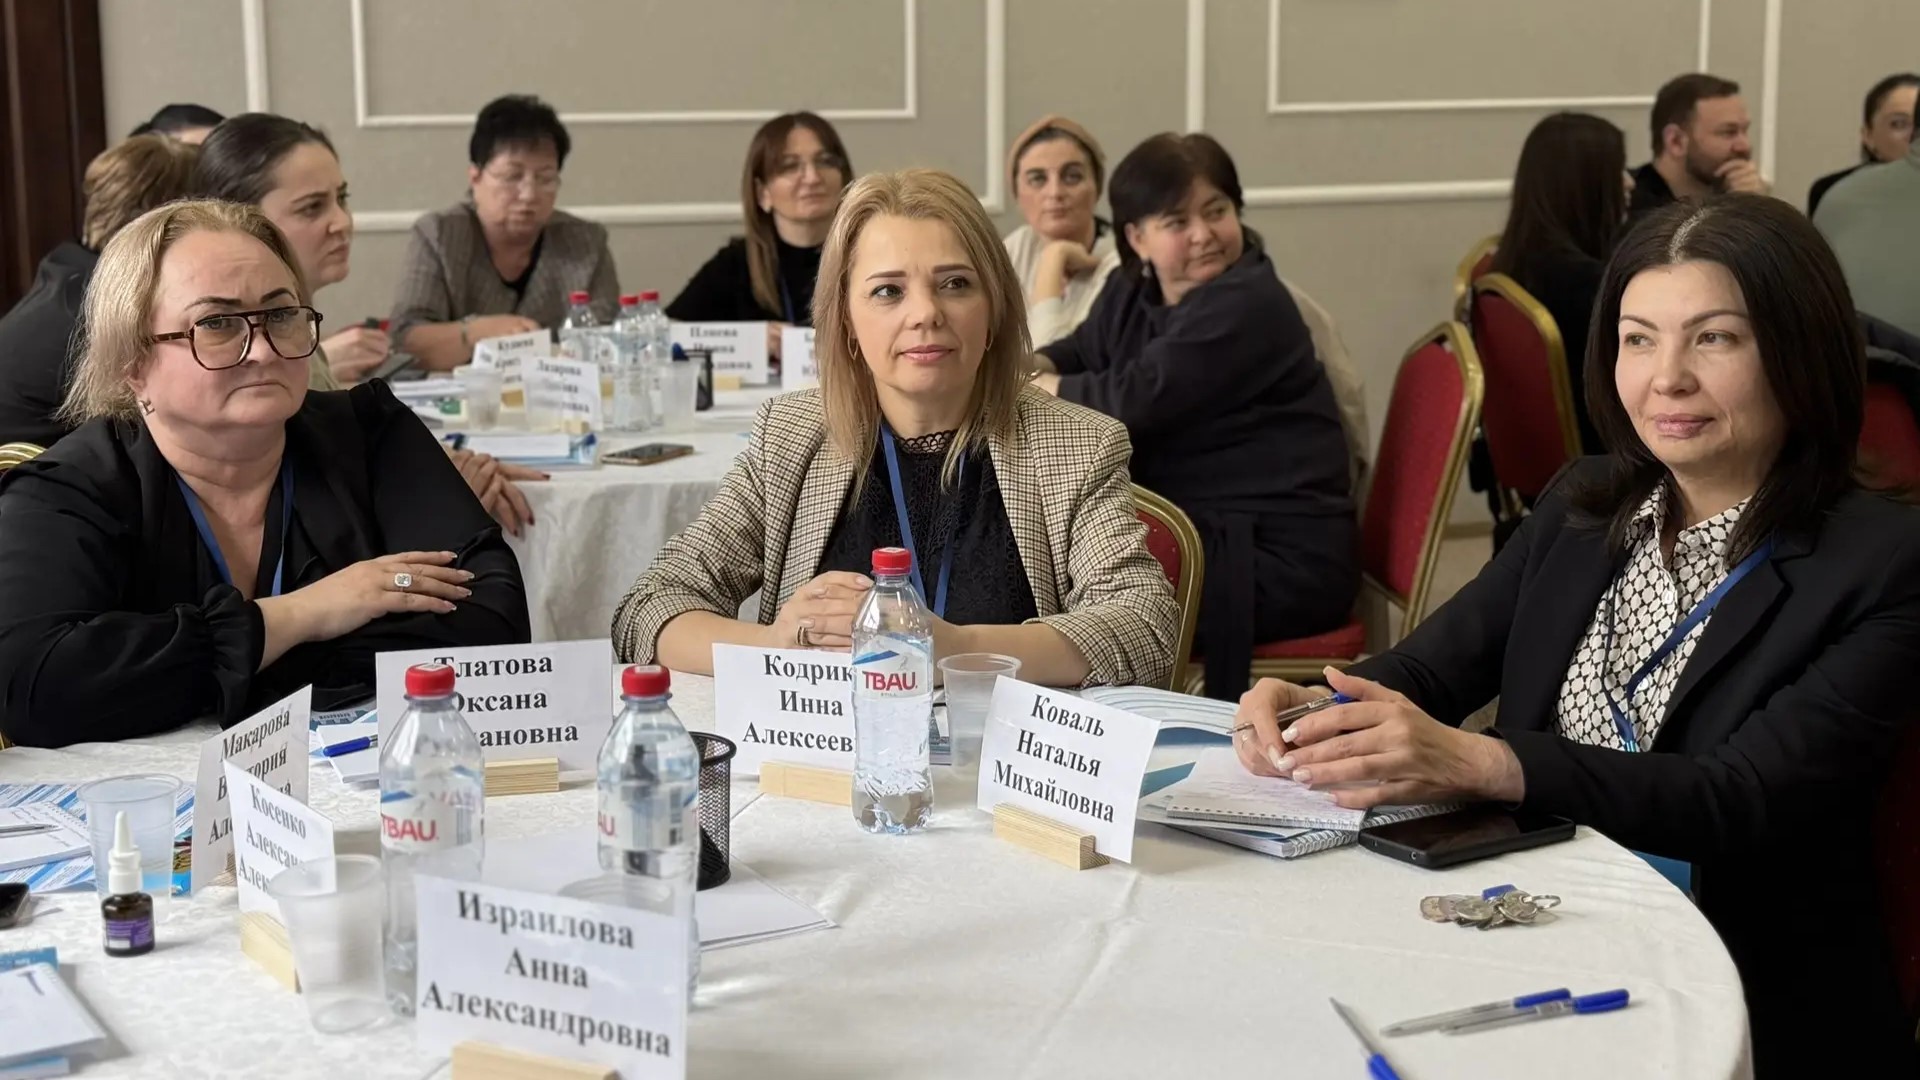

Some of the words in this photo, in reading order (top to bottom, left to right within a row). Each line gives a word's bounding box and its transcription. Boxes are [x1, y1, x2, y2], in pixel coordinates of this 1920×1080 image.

[780, 689, 843, 717] Инна
[1030, 693, 1105, 737] Коваль
[219, 708, 291, 763] Макарова
[479, 724, 579, 748] ановна
[742, 721, 853, 752] Алексеев
[1016, 728, 1103, 778] Наталья
[249, 783, 307, 840] Косенко
[993, 759, 1115, 823] Михайловна
[457, 889, 635, 949] Израилова
[503, 947, 589, 989] Анна
[421, 980, 671, 1057] Александровна
